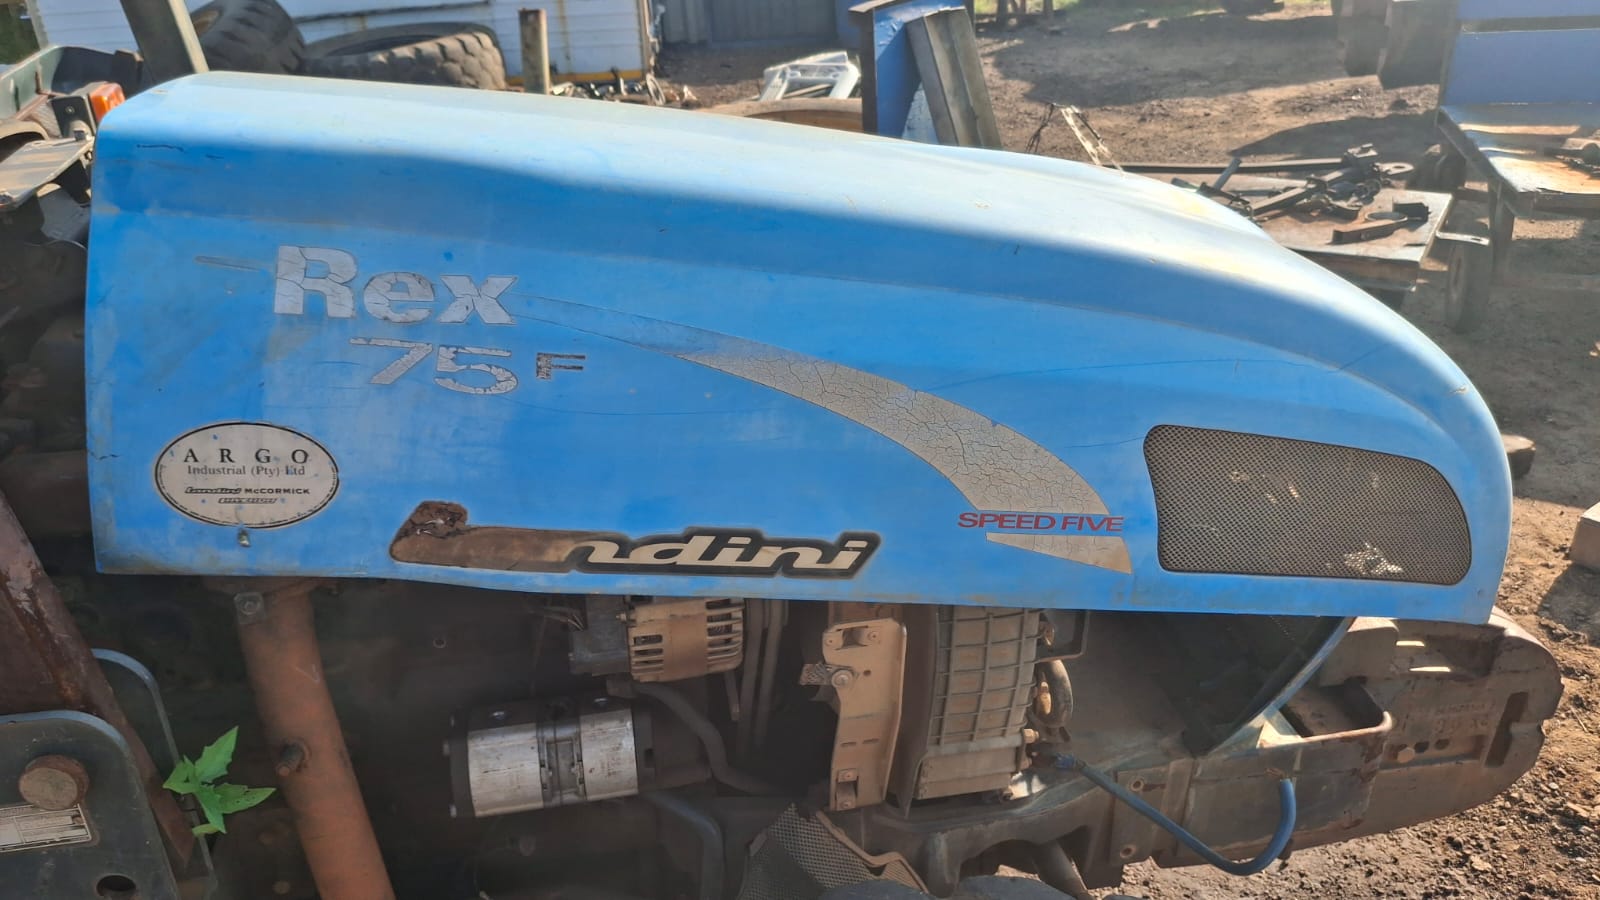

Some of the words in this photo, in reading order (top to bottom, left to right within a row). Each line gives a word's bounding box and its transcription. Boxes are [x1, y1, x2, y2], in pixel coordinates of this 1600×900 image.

[274, 245, 519, 325] Rex
[350, 337, 519, 395] 75
[536, 352, 587, 381] F
[184, 448, 309, 464] ARGO
[187, 465, 246, 476] Industrial
[251, 465, 280, 478] (Pty)
[957, 512, 1056, 530] SPEED
[1061, 516, 1125, 532] FIVE
